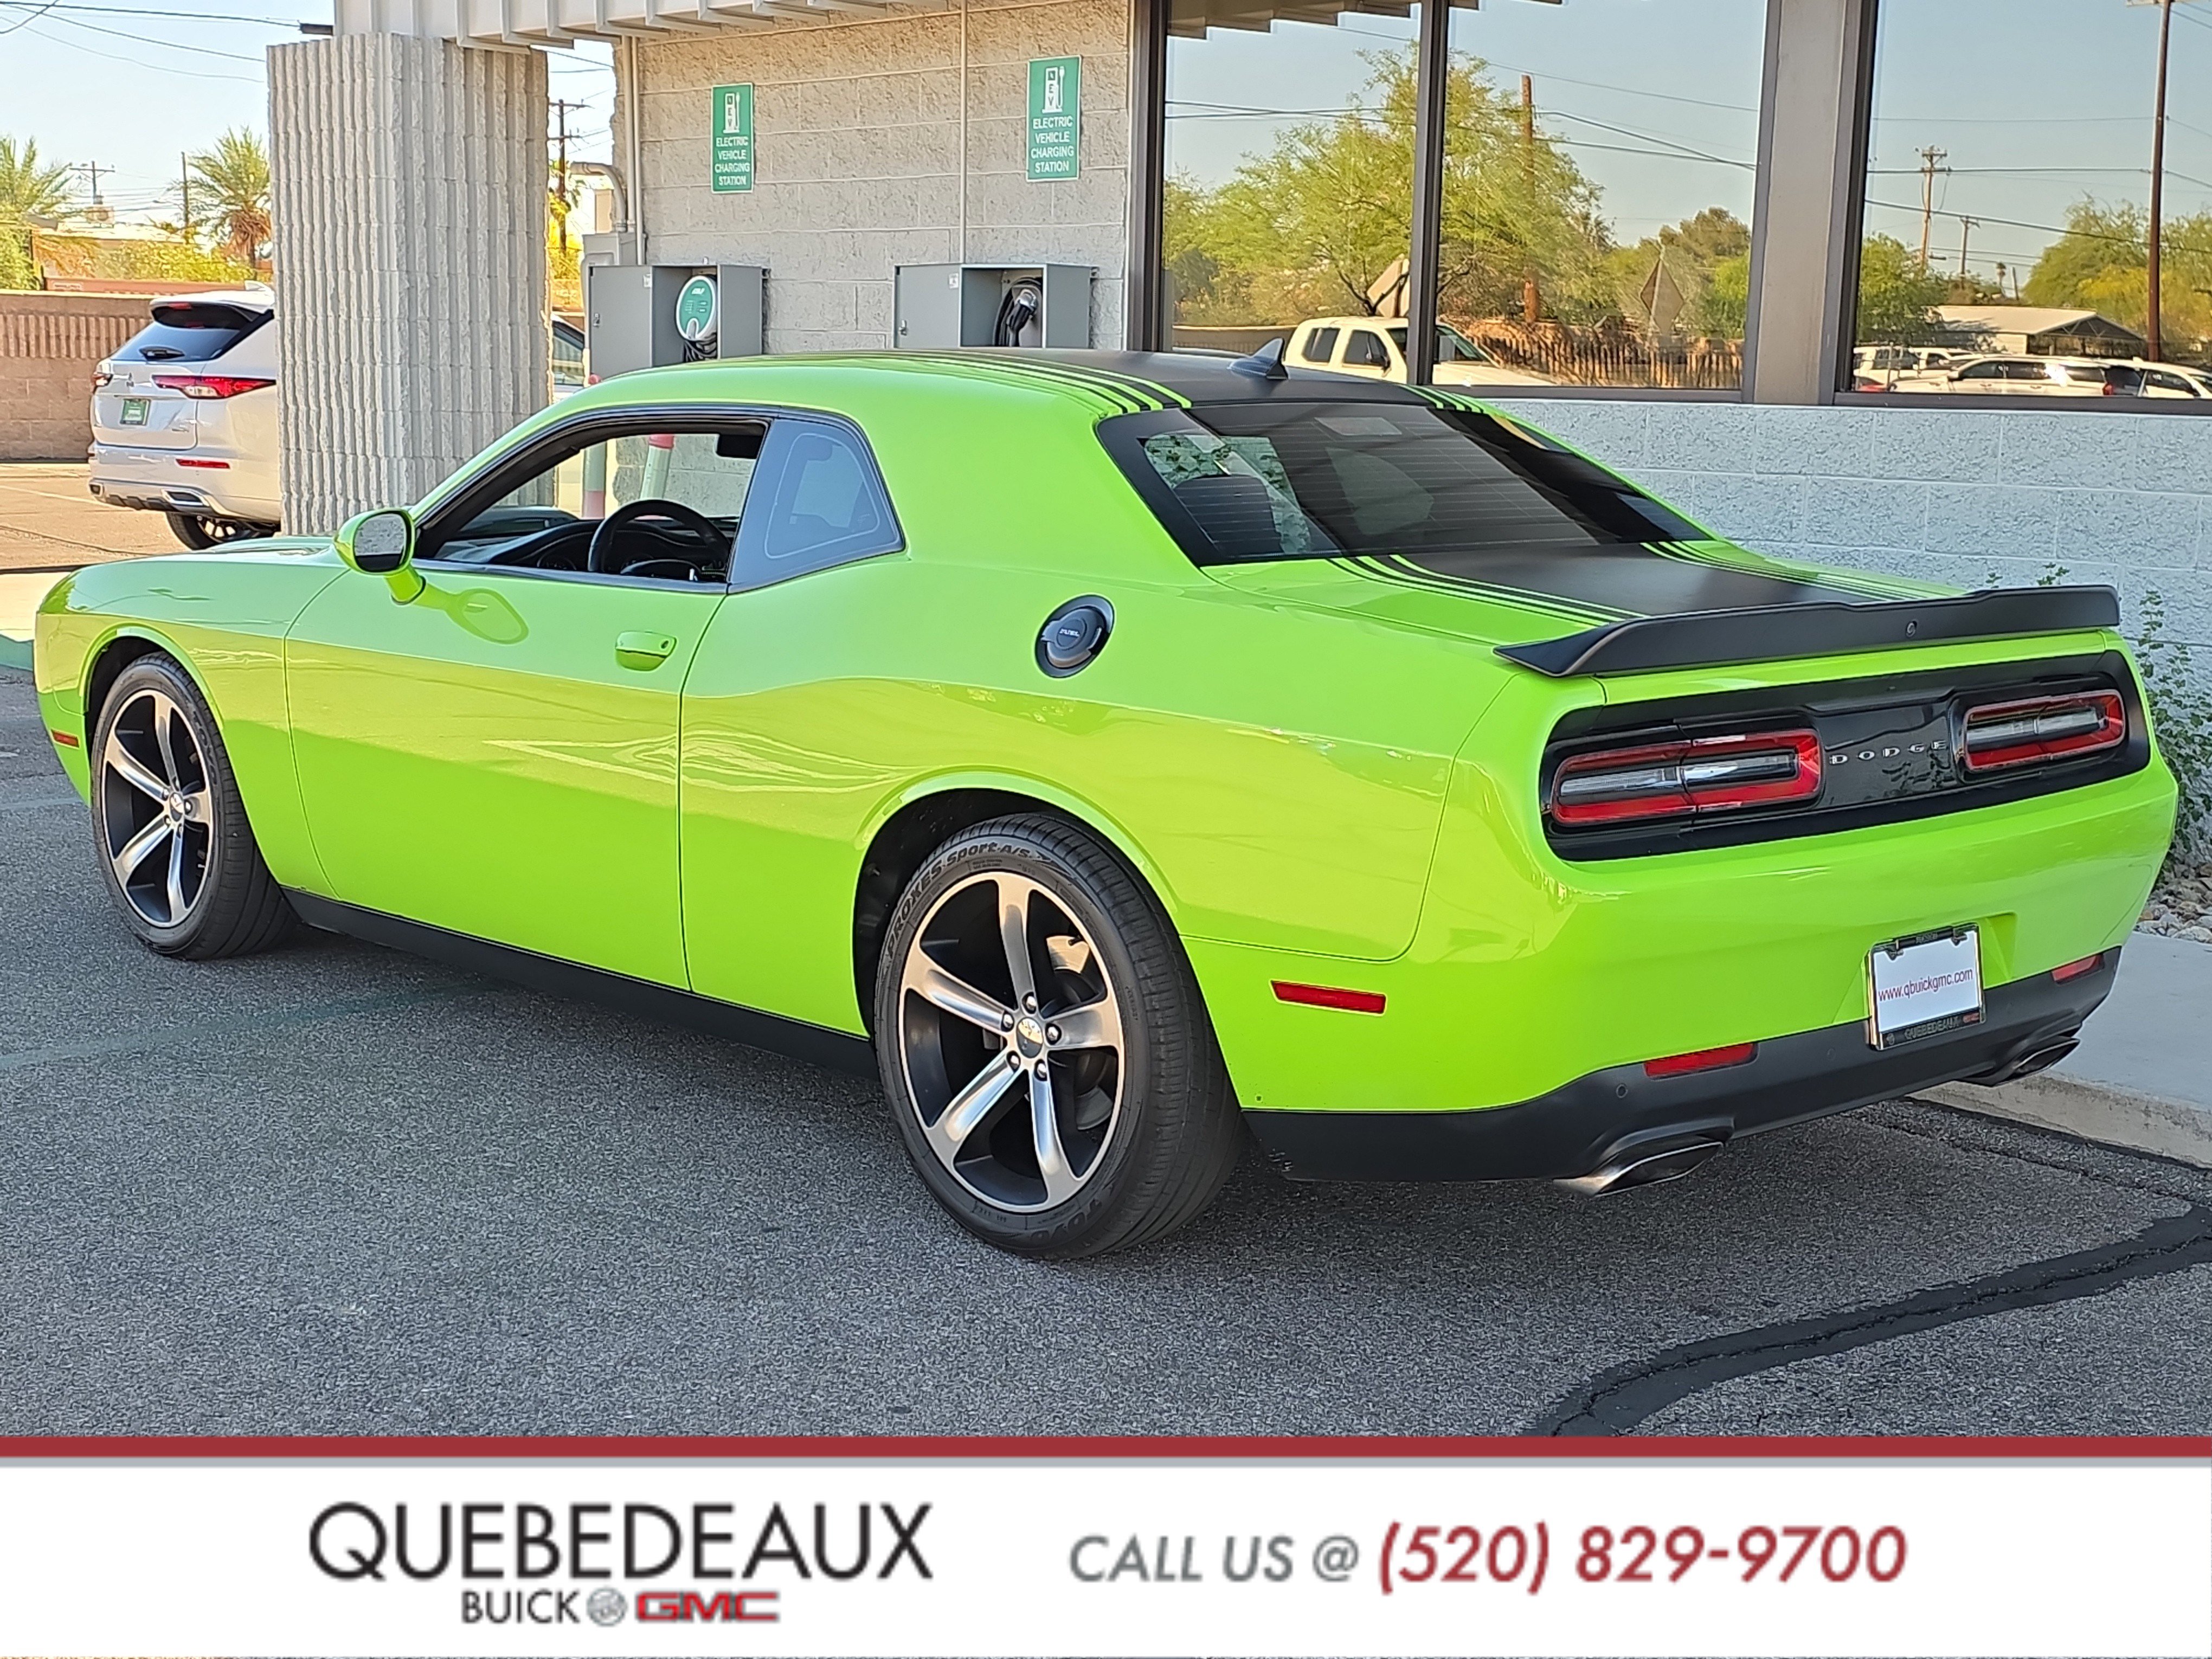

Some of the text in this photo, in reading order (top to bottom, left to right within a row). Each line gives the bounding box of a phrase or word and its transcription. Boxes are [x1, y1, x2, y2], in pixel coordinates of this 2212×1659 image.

[1033, 115, 1073, 129] ELECTRIC
[716, 137, 749, 147] ELECTRIC
[1035, 131, 1070, 144] VEHICLE
[717, 150, 747, 160] VEHICLE
[1031, 145, 1074, 159] CHARGING
[715, 162, 750, 173] CHARGING
[1035, 160, 1069, 173] STATION
[718, 175, 747, 186] STATION
[1829, 740, 1946, 765] DODGE
[1878, 969, 1973, 1002] www.qbuickgmc.com
